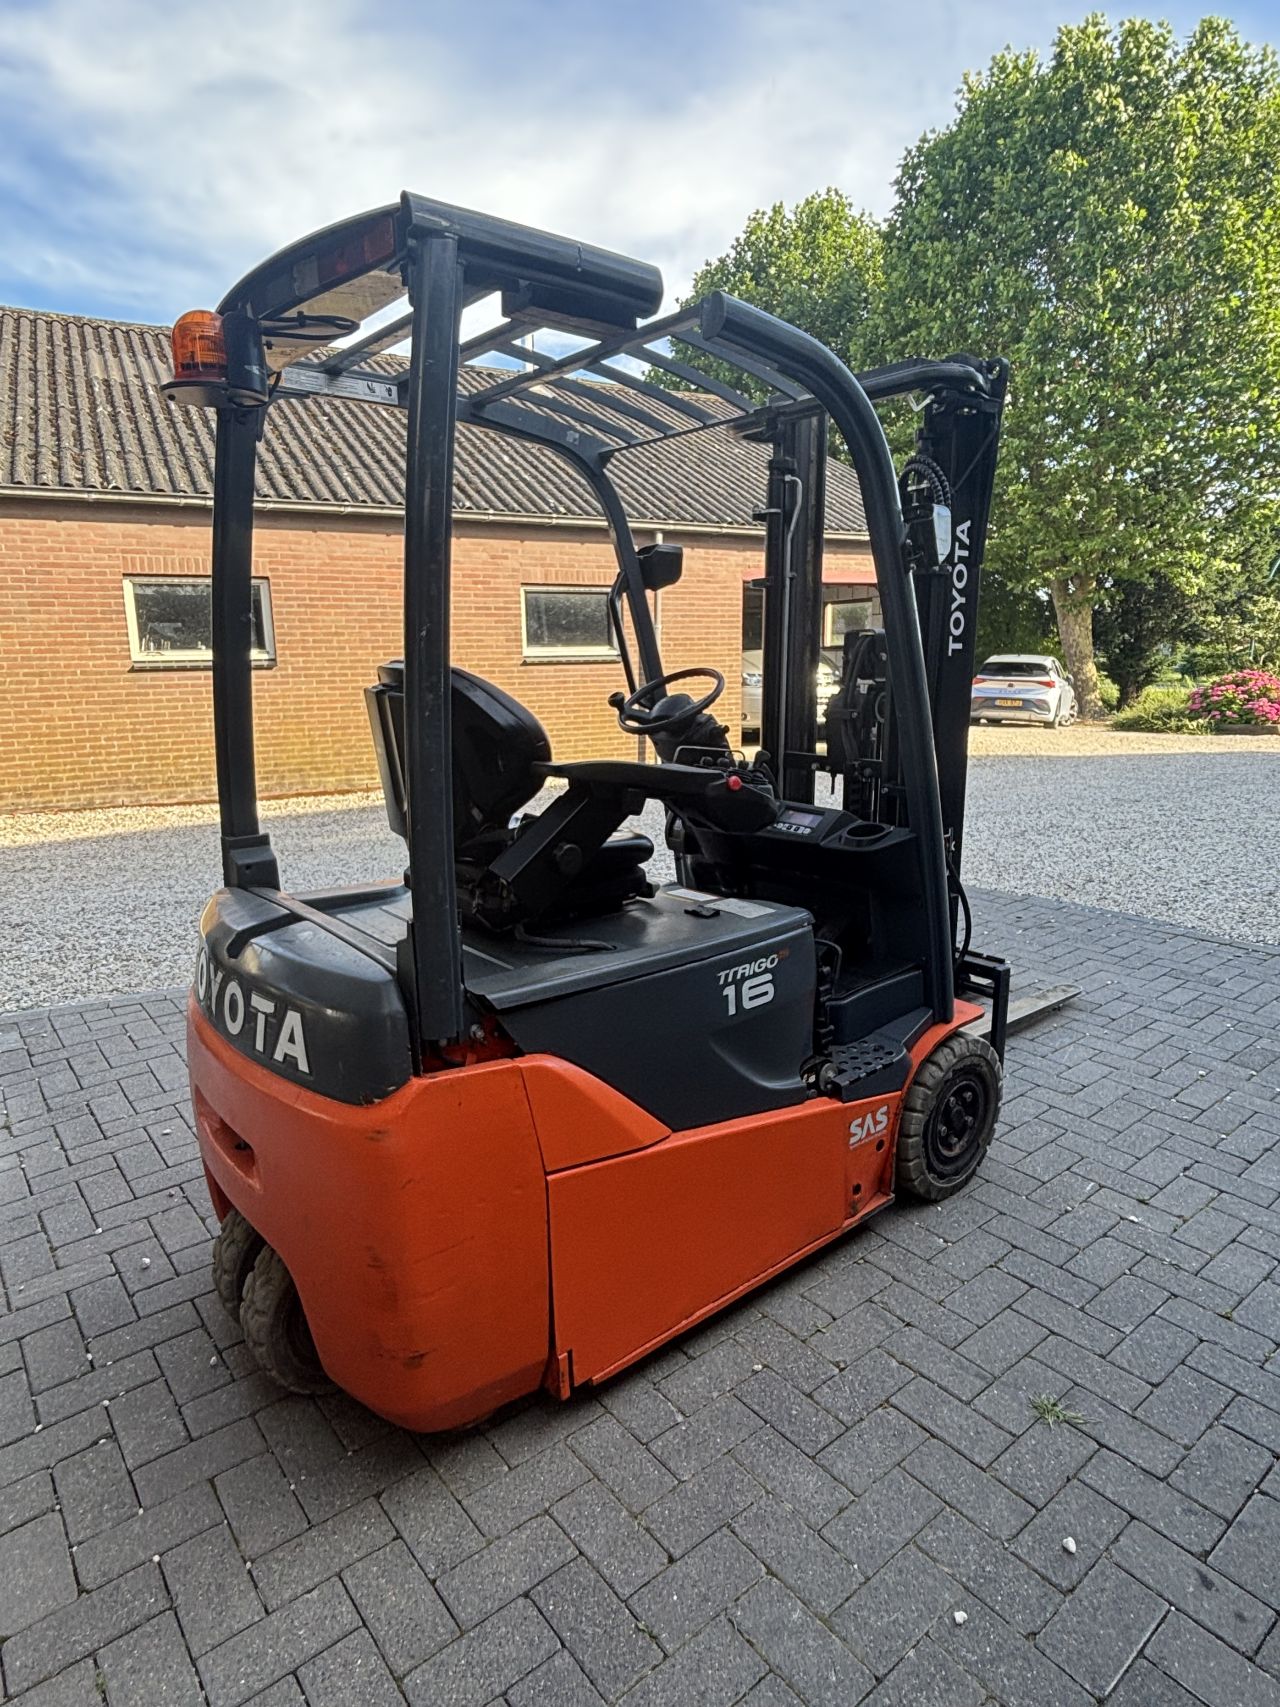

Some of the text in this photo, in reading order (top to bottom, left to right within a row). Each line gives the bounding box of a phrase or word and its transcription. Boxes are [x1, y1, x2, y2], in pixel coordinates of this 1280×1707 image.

[948, 519, 971, 656] TOYOTA
[198, 949, 309, 1074] OYOTA
[722, 972, 775, 1016] 16
[849, 1105, 888, 1145] SAS
